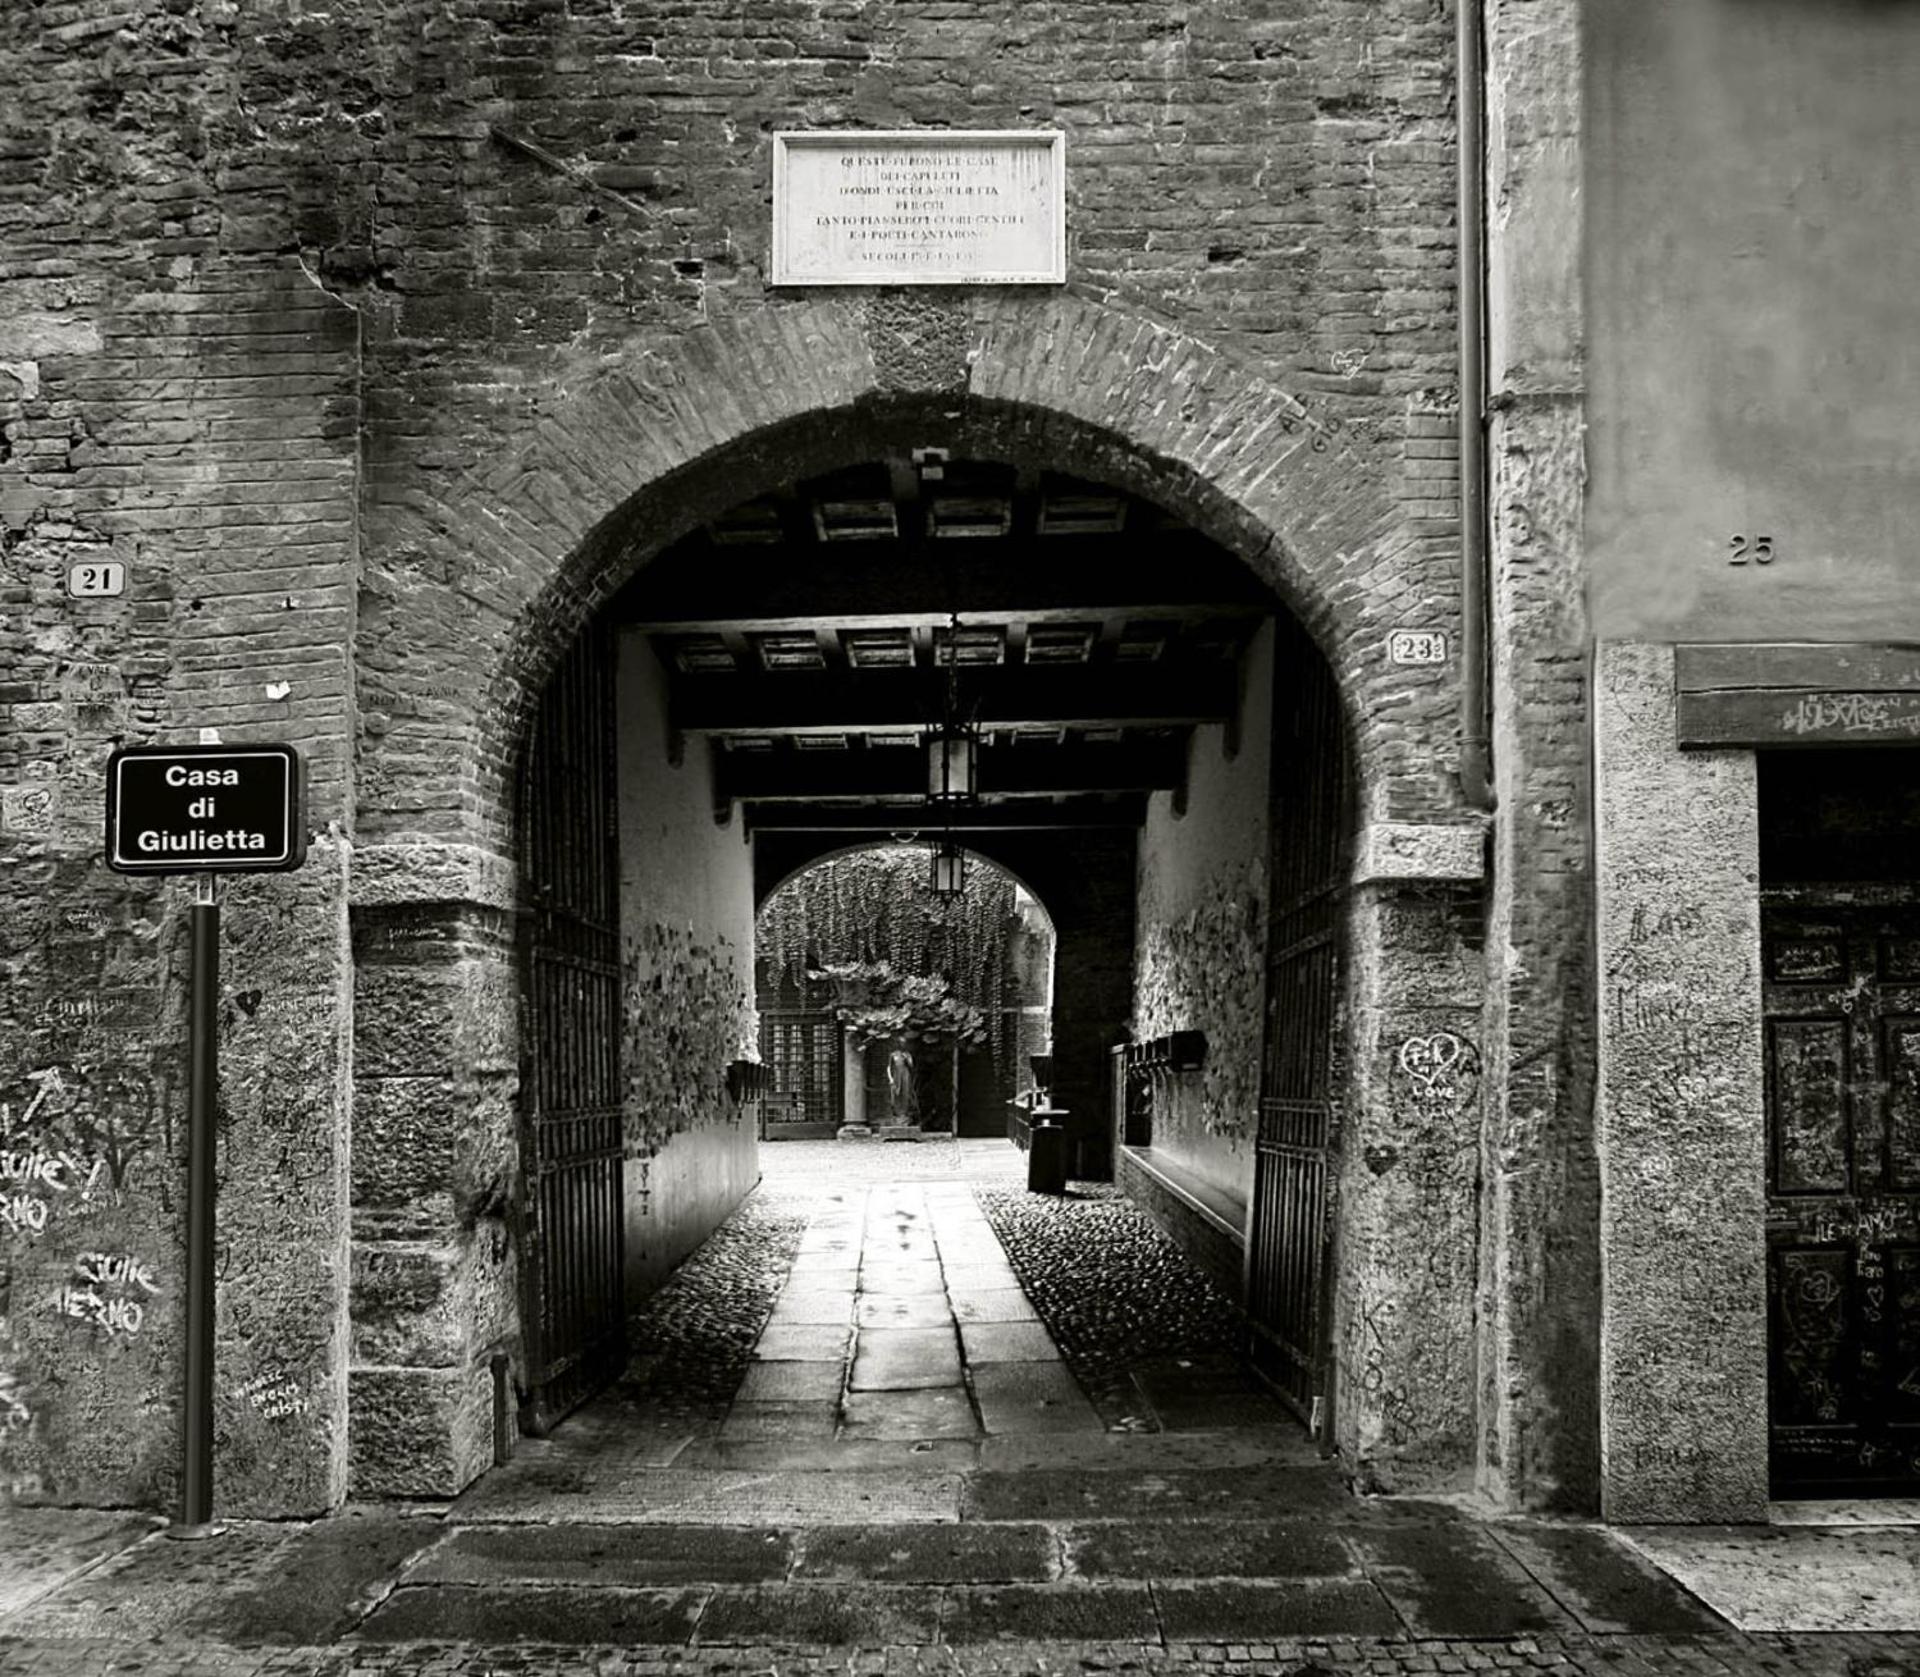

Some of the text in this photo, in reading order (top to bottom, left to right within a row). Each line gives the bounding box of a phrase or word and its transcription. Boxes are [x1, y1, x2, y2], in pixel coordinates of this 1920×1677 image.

[1728, 535, 1774, 566] 25
[82, 568, 110, 590] 21
[1401, 637, 1432, 659] 23
[165, 765, 239, 787] Casa
[188, 797, 215, 818] di
[138, 829, 266, 852] Giulietta
[1412, 1085, 1456, 1099] LOVE
